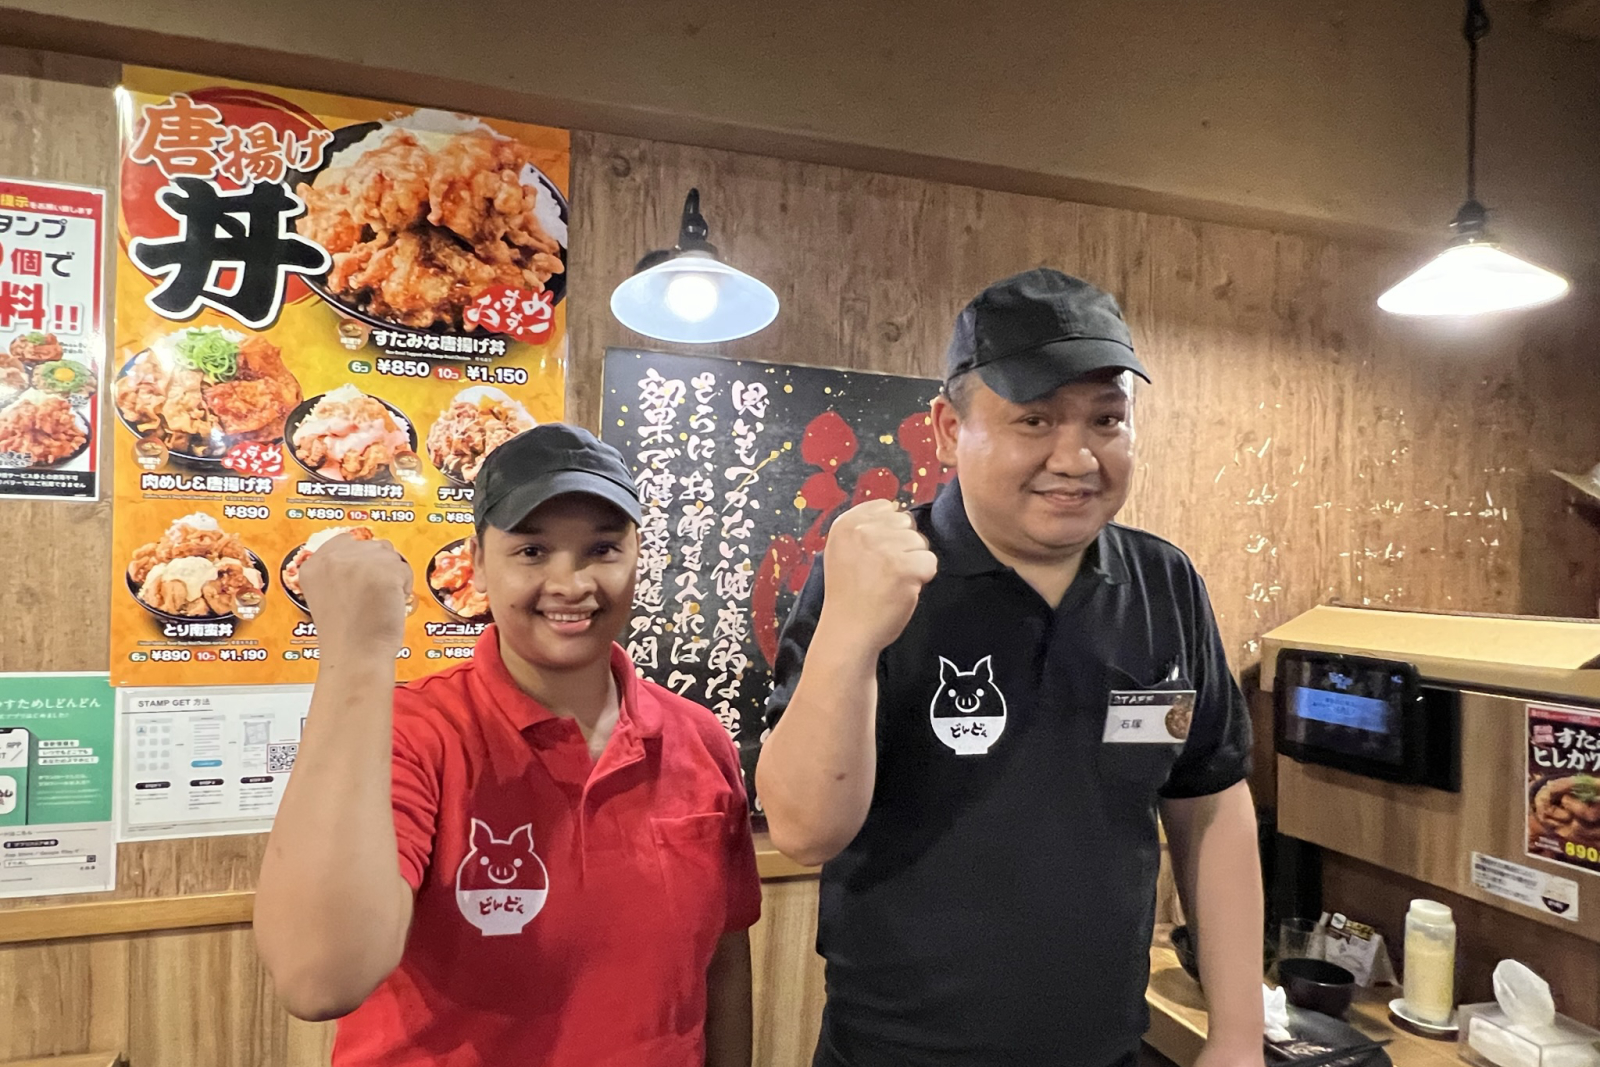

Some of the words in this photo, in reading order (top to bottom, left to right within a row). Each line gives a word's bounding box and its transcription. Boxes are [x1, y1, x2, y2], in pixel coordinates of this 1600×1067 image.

[130, 93, 334, 184] 唐揚げ
[0, 241, 75, 277] 個で
[130, 177, 331, 327] 丼
[372, 329, 506, 356] すたみな唐揚げ丼
[376, 359, 430, 377] ¥850
[466, 365, 528, 384] ¥1,150
[224, 505, 270, 519] ¥890
[306, 507, 345, 520] ¥890
[446, 512, 475, 523] ¥89
[426, 623, 489, 636] ヤンニョムチ
[151, 649, 192, 661] ¥890
[138, 700, 170, 708] STAMP
[172, 699, 191, 707] GET
[1554, 727, 1600, 750] すた
[1565, 841, 1600, 863] 890
